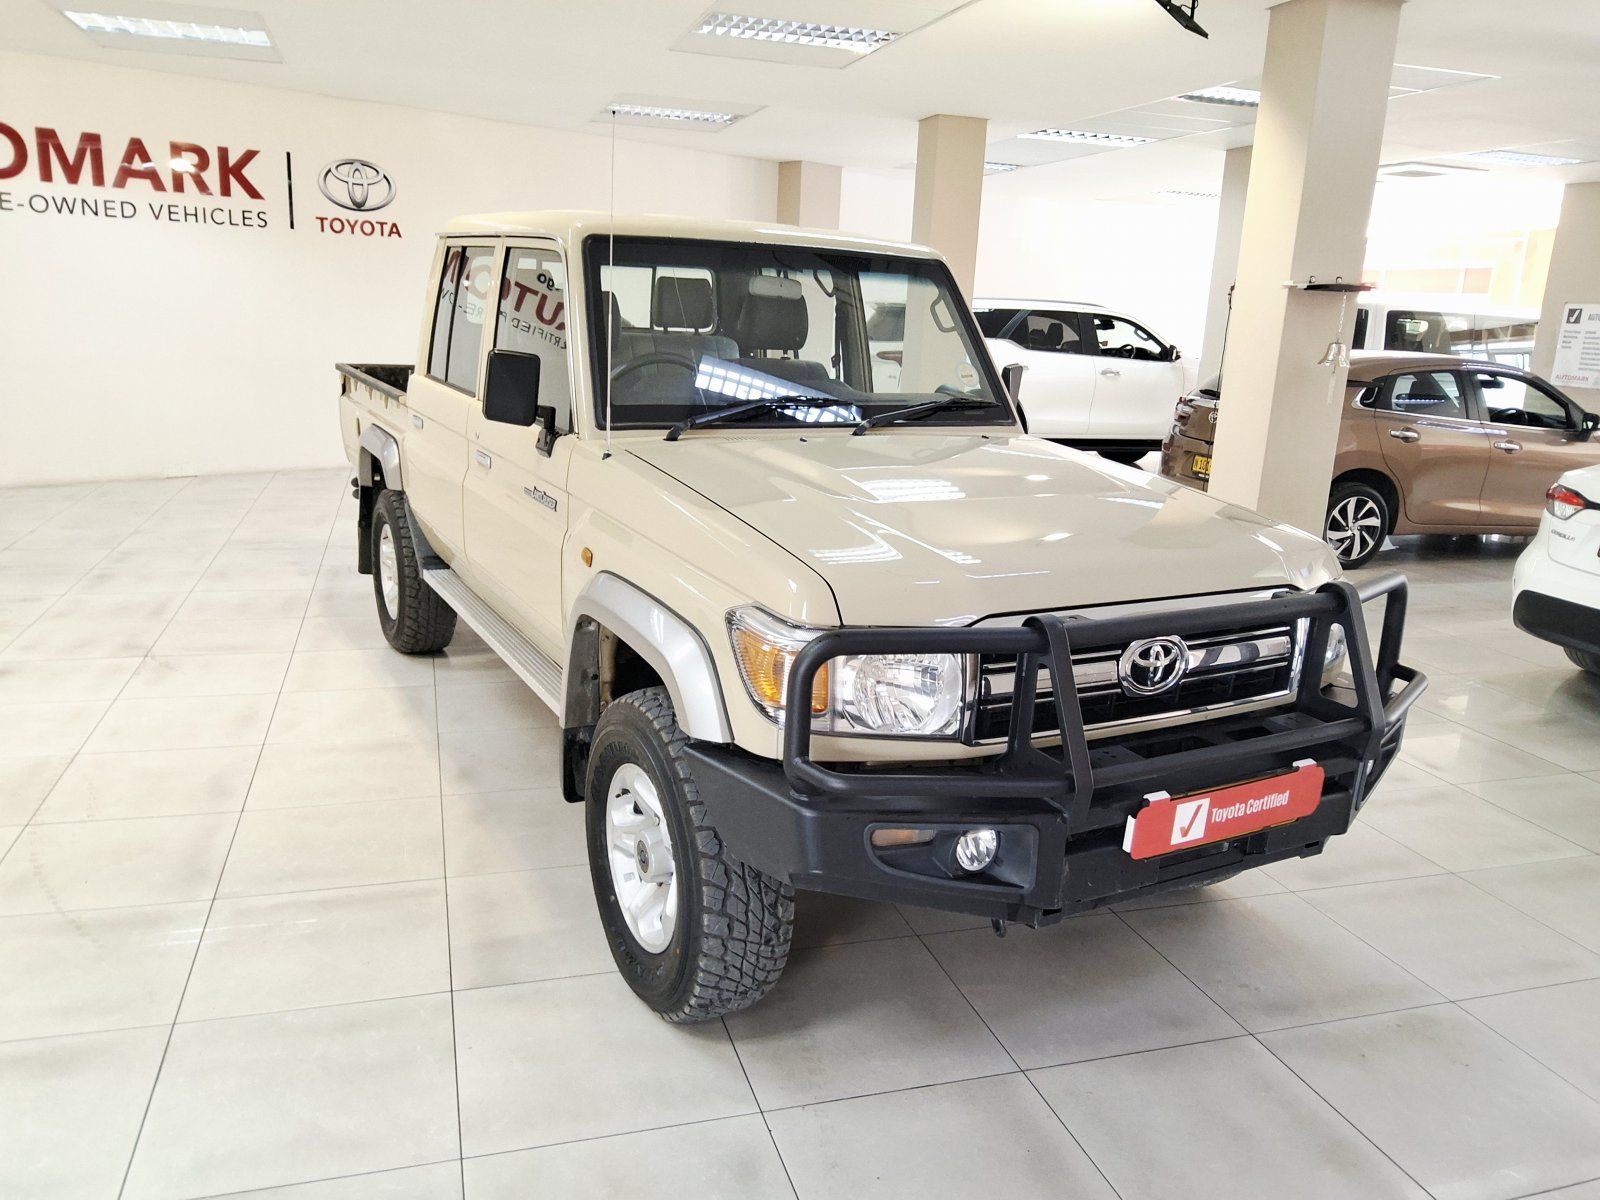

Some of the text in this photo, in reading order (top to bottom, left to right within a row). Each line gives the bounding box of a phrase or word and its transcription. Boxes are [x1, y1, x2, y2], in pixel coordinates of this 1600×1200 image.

[148, 202, 268, 229] VEHICLES
[315, 216, 403, 239] TOYOTA
[1211, 790, 1290, 823] Toyota Certified
